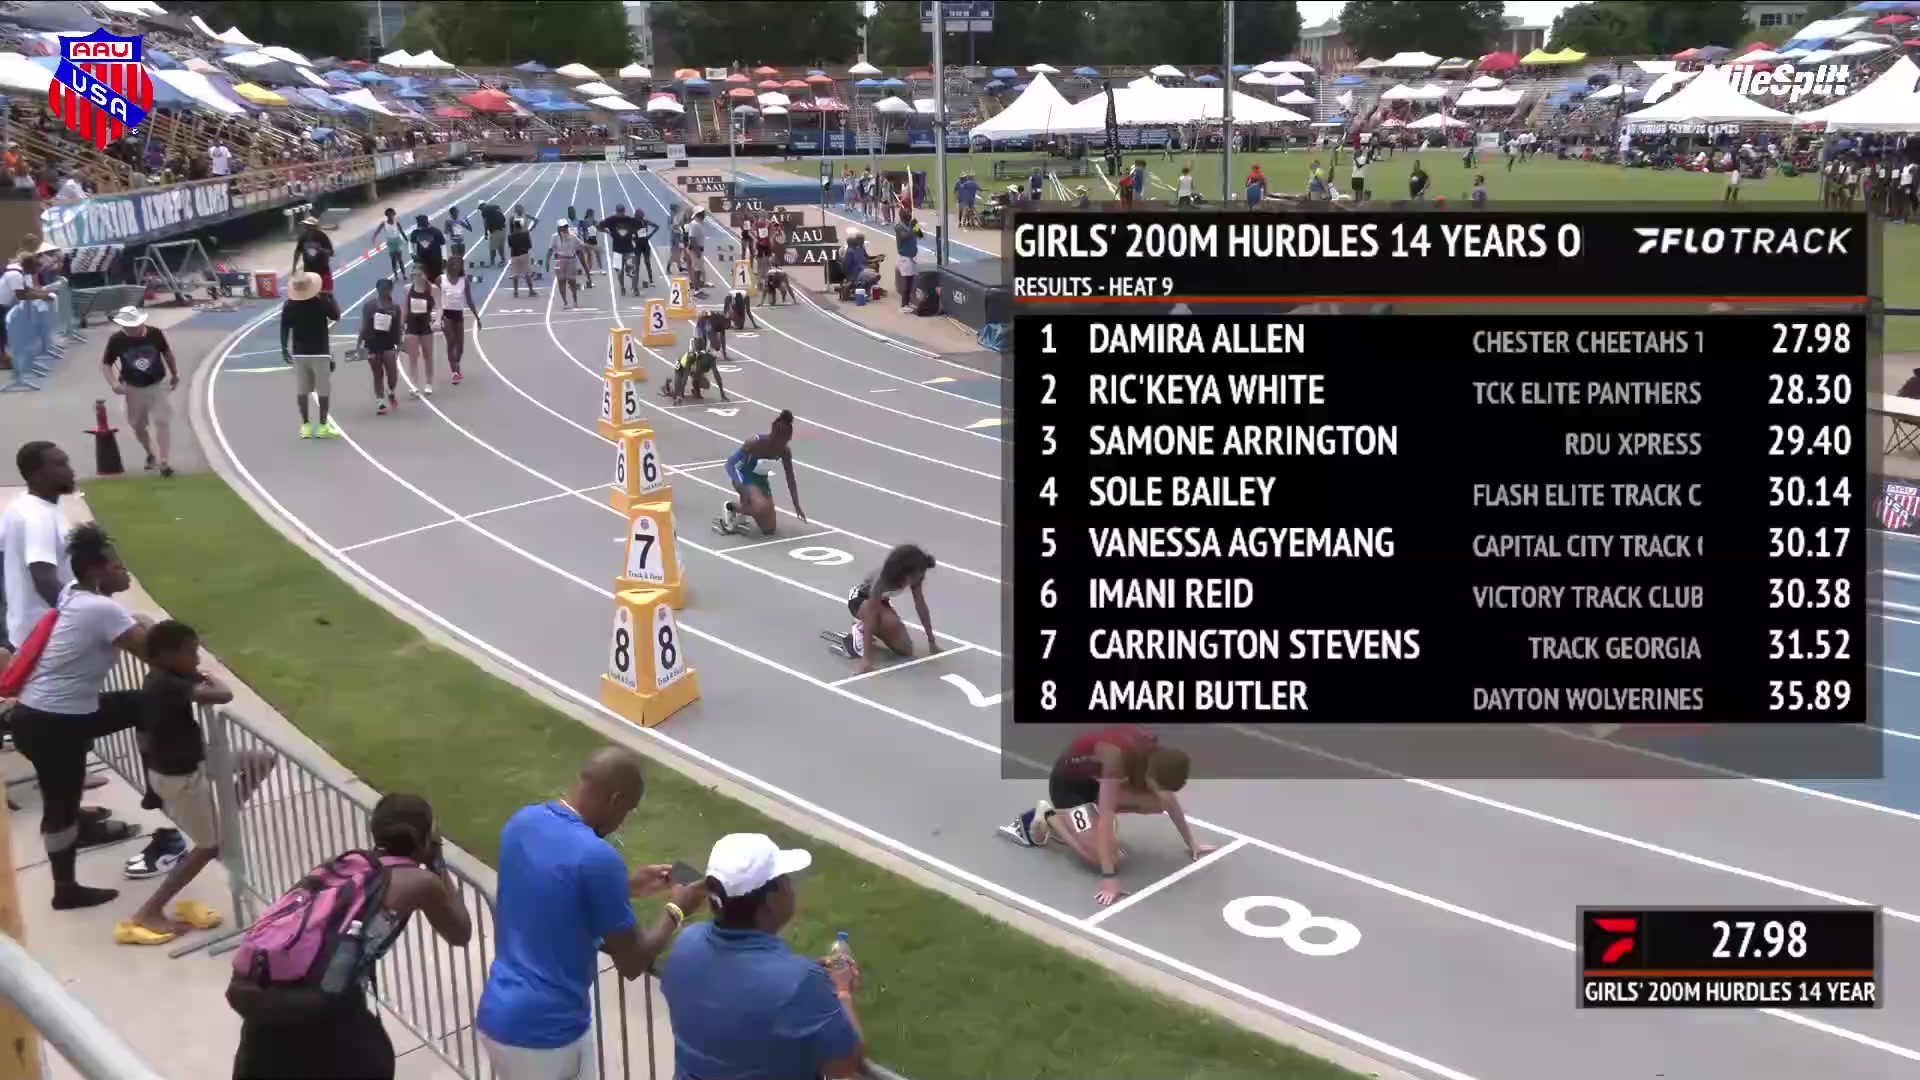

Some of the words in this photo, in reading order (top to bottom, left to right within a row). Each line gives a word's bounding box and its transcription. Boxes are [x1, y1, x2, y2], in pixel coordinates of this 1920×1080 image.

[791, 229, 823, 243] AAU
[738, 270, 746, 284] 1
[672, 289, 681, 305] 2
[652, 311, 664, 329] 3
[624, 343, 635, 363] 4
[625, 390, 637, 415] 5
[617, 453, 625, 483] 6
[643, 452, 657, 483] 6
[634, 533, 655, 570] 7
[615, 627, 630, 673] 8
[658, 625, 676, 670] 8
[1073, 810, 1087, 830] 8
[1223, 895, 1362, 956] 8
